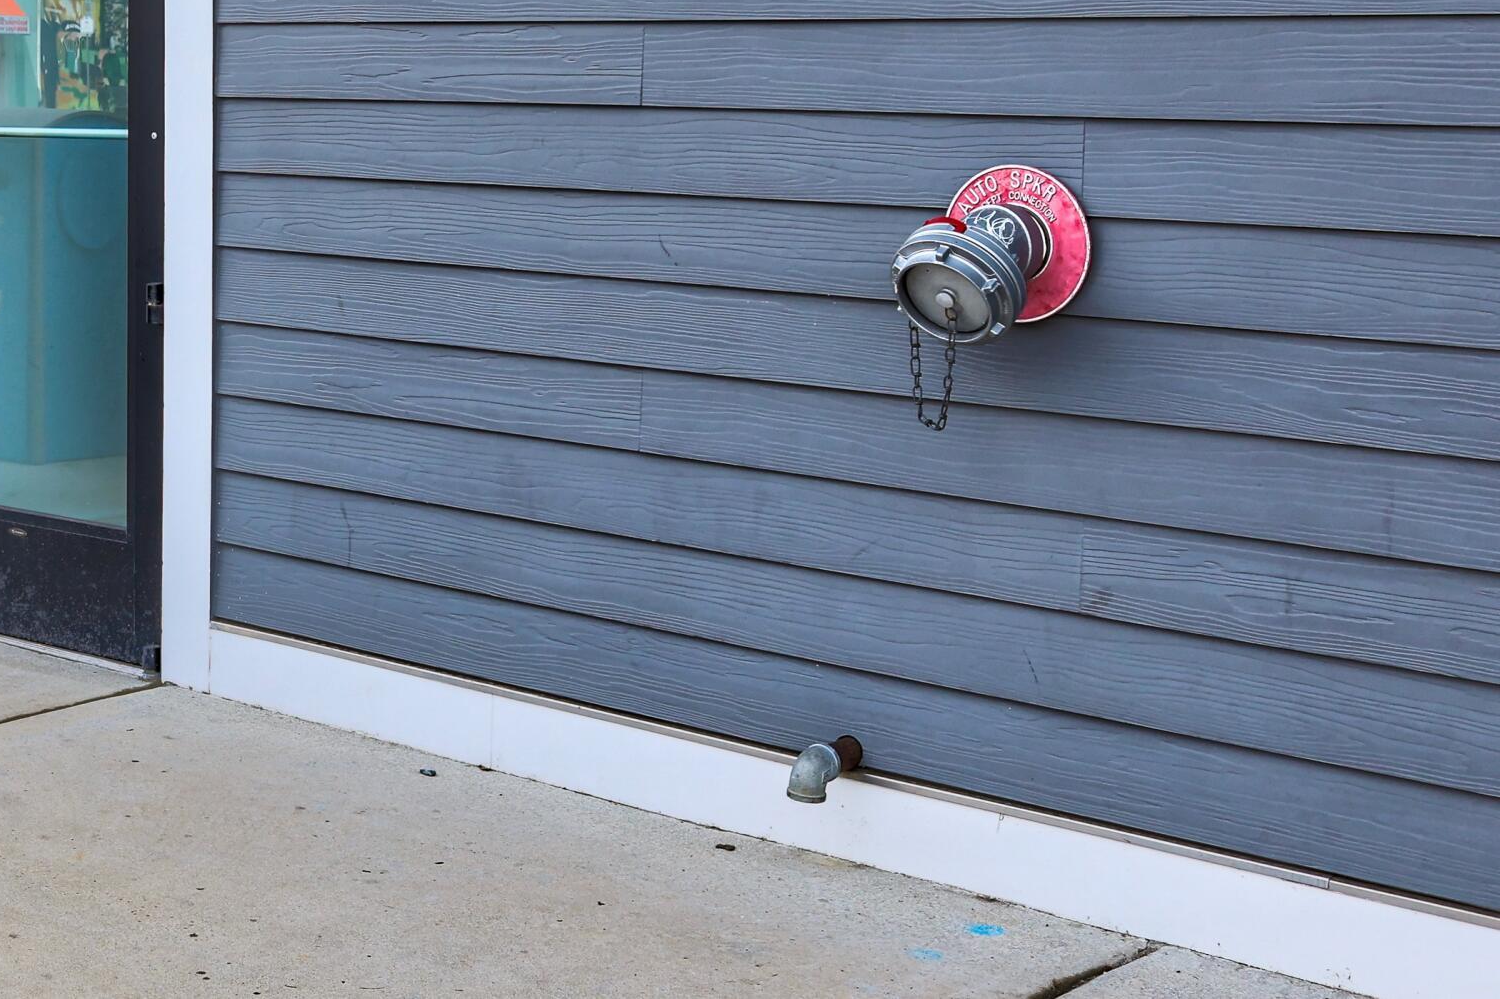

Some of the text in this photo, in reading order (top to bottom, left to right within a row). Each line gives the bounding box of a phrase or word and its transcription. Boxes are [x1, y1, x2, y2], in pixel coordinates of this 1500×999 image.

[957, 171, 1057, 217] AUTO SPKR
[1008, 191, 1057, 223] CONNECTION
